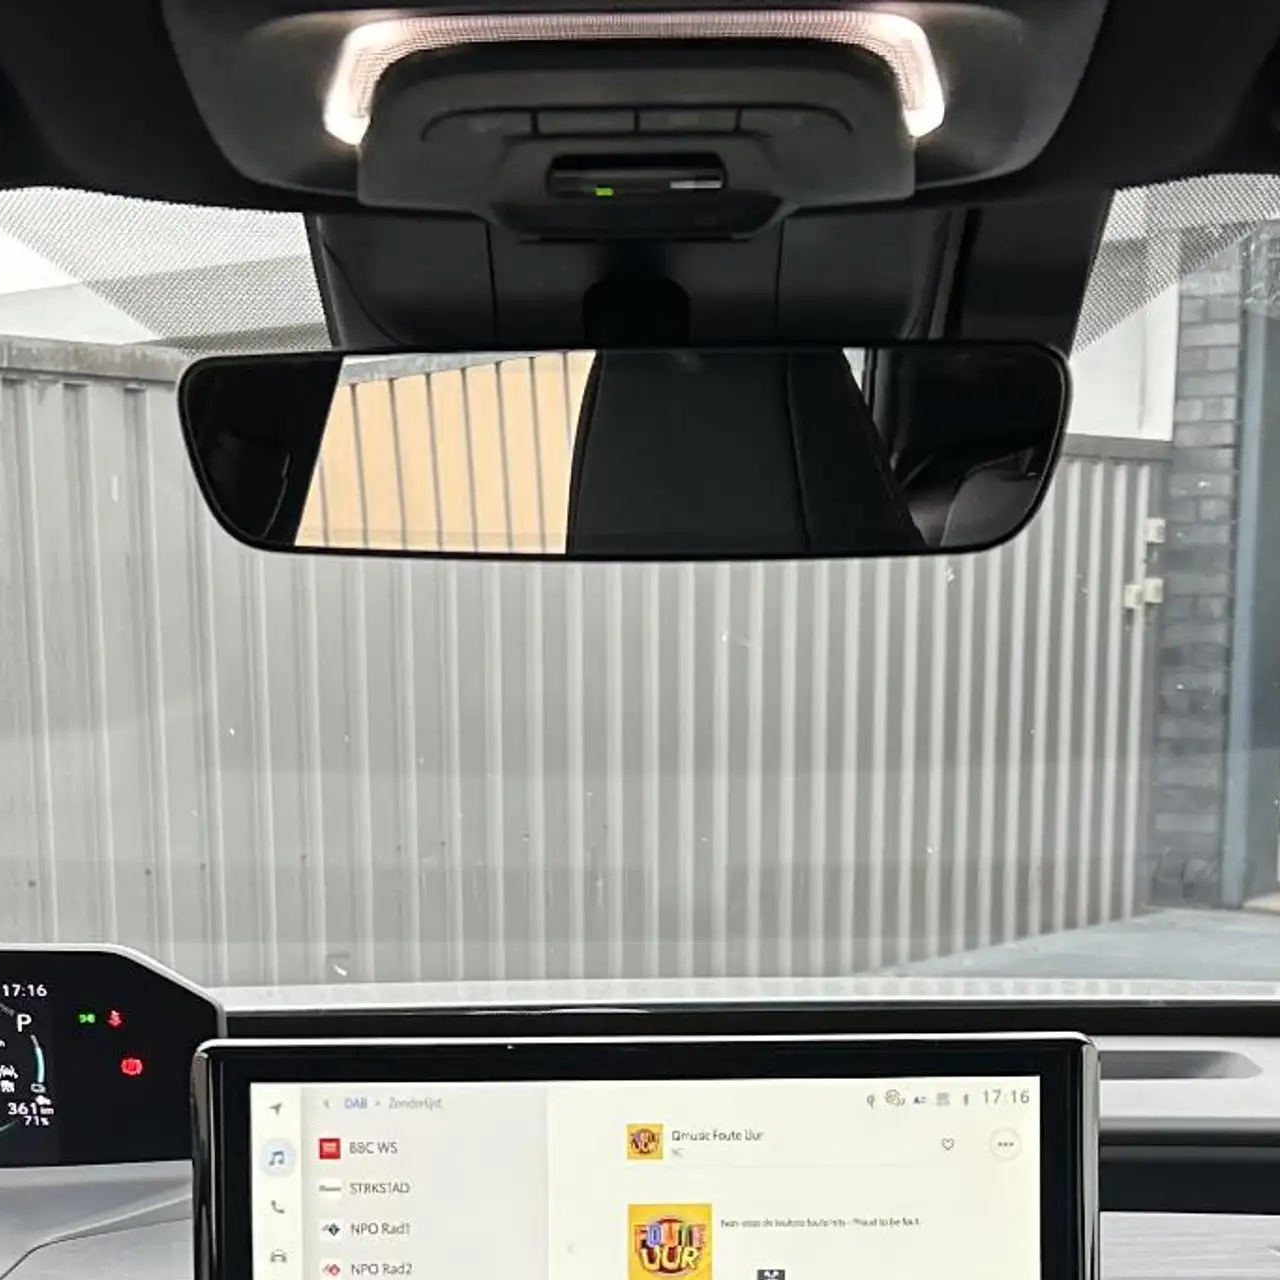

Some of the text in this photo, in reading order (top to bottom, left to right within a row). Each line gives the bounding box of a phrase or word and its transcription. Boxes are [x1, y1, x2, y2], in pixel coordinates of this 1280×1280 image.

[2, 984, 48, 997] 17:16
[16, 1013, 32, 1032] P
[983, 1089, 1030, 1104] 17:16
[8, 1102, 37, 1115] 361
[344, 1097, 368, 1109] DAB
[24, 1116, 49, 1126] 71%
[349, 1142, 398, 1154] BBC WS
[351, 1223, 411, 1235] NPO Rad1
[640, 1245, 700, 1271] UUR
[351, 1263, 413, 1275] NPO Rad2
